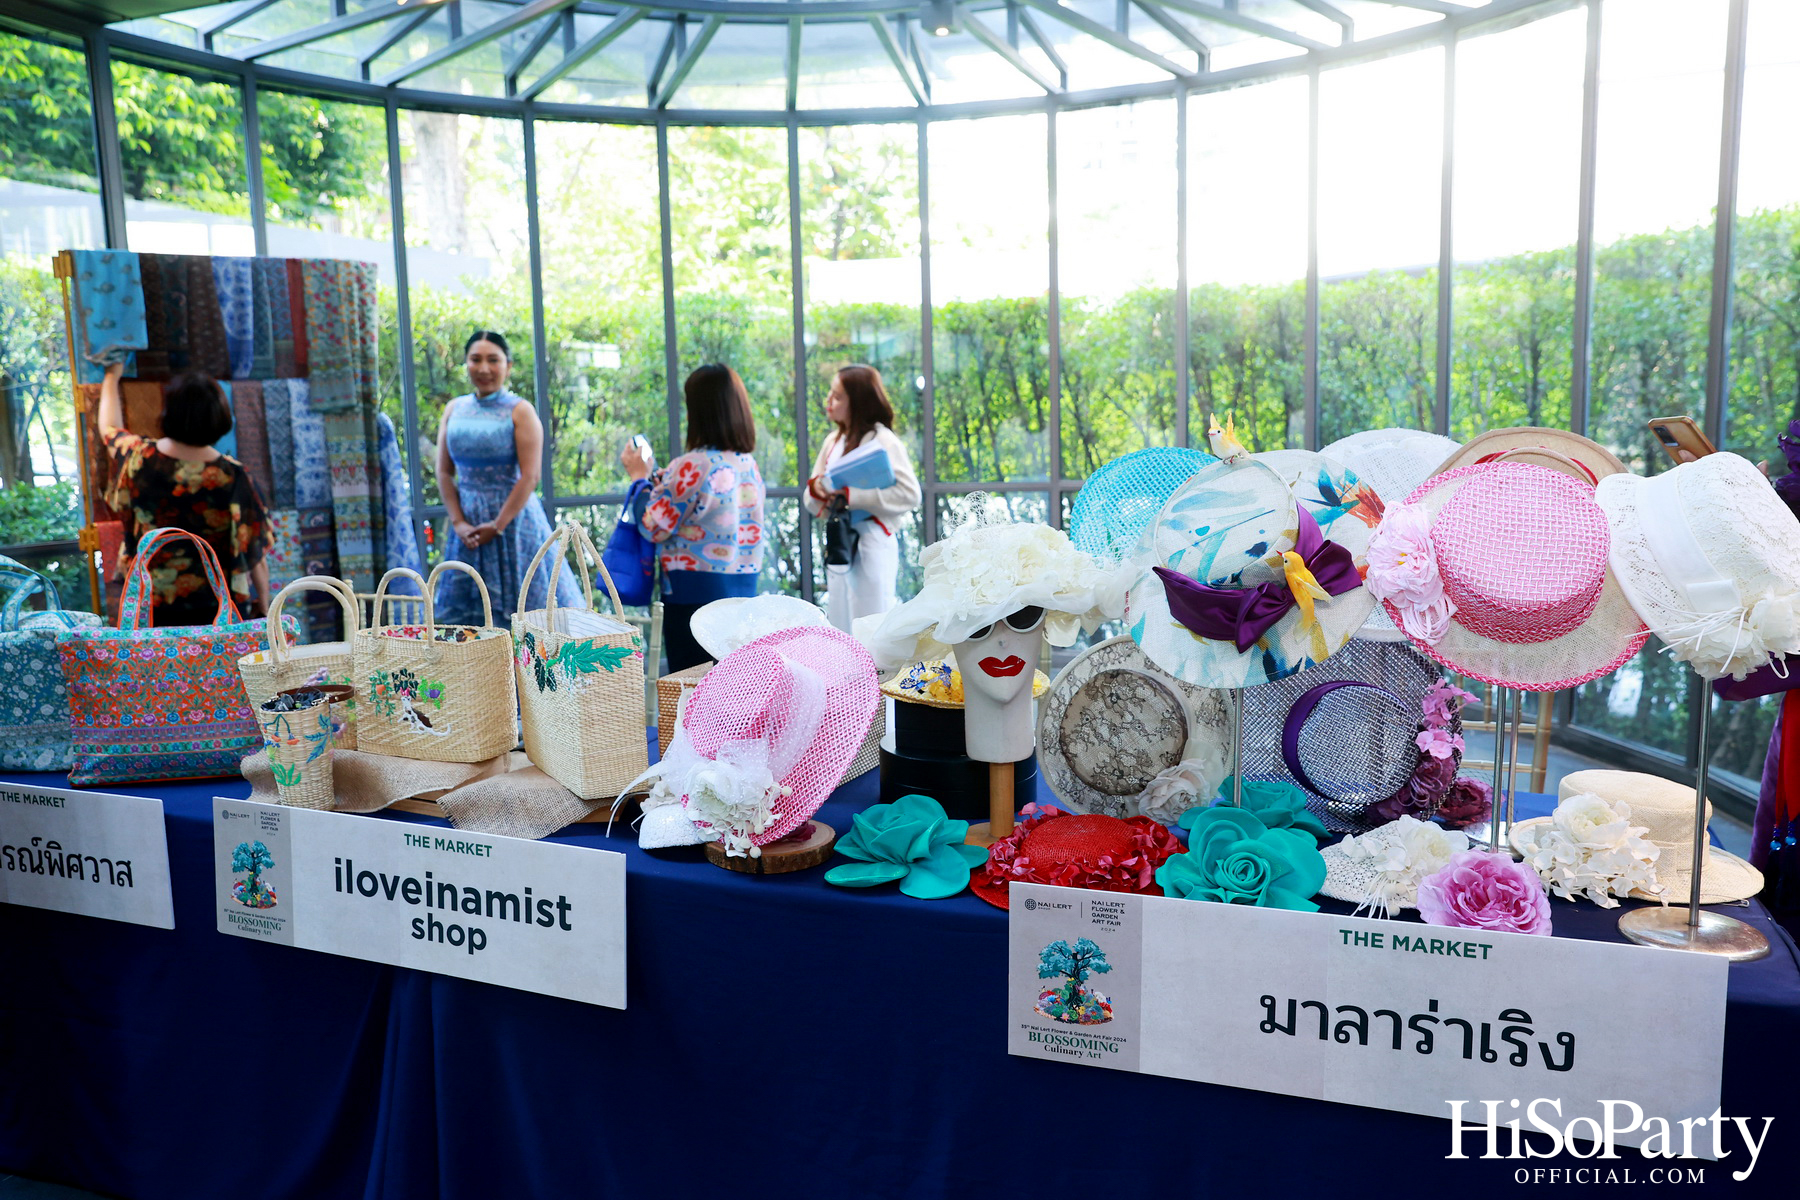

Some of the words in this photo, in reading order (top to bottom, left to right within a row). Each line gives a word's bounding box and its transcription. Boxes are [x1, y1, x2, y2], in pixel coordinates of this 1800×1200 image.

[0, 791, 20, 803] THE
[23, 793, 66, 808] MARKET
[404, 833, 431, 849] THE
[435, 838, 493, 858] MARKET
[0, 837, 133, 888] รณ์พิศวาส
[334, 857, 572, 931] iloveinamist
[1091, 906, 1118, 914] FLOWER
[228, 914, 282, 931] BLOSSOMING
[237, 924, 261, 935] Culinary
[411, 912, 487, 955] shop
[1339, 929, 1384, 949] THE
[1392, 934, 1493, 960] MARKET
[1028, 1031, 1119, 1054] BLOSSOMING
[1259, 994, 1575, 1072] มาลาร่าเริง
[1044, 1044, 1084, 1058] Culinary
[1086, 1051, 1102, 1059] Art
